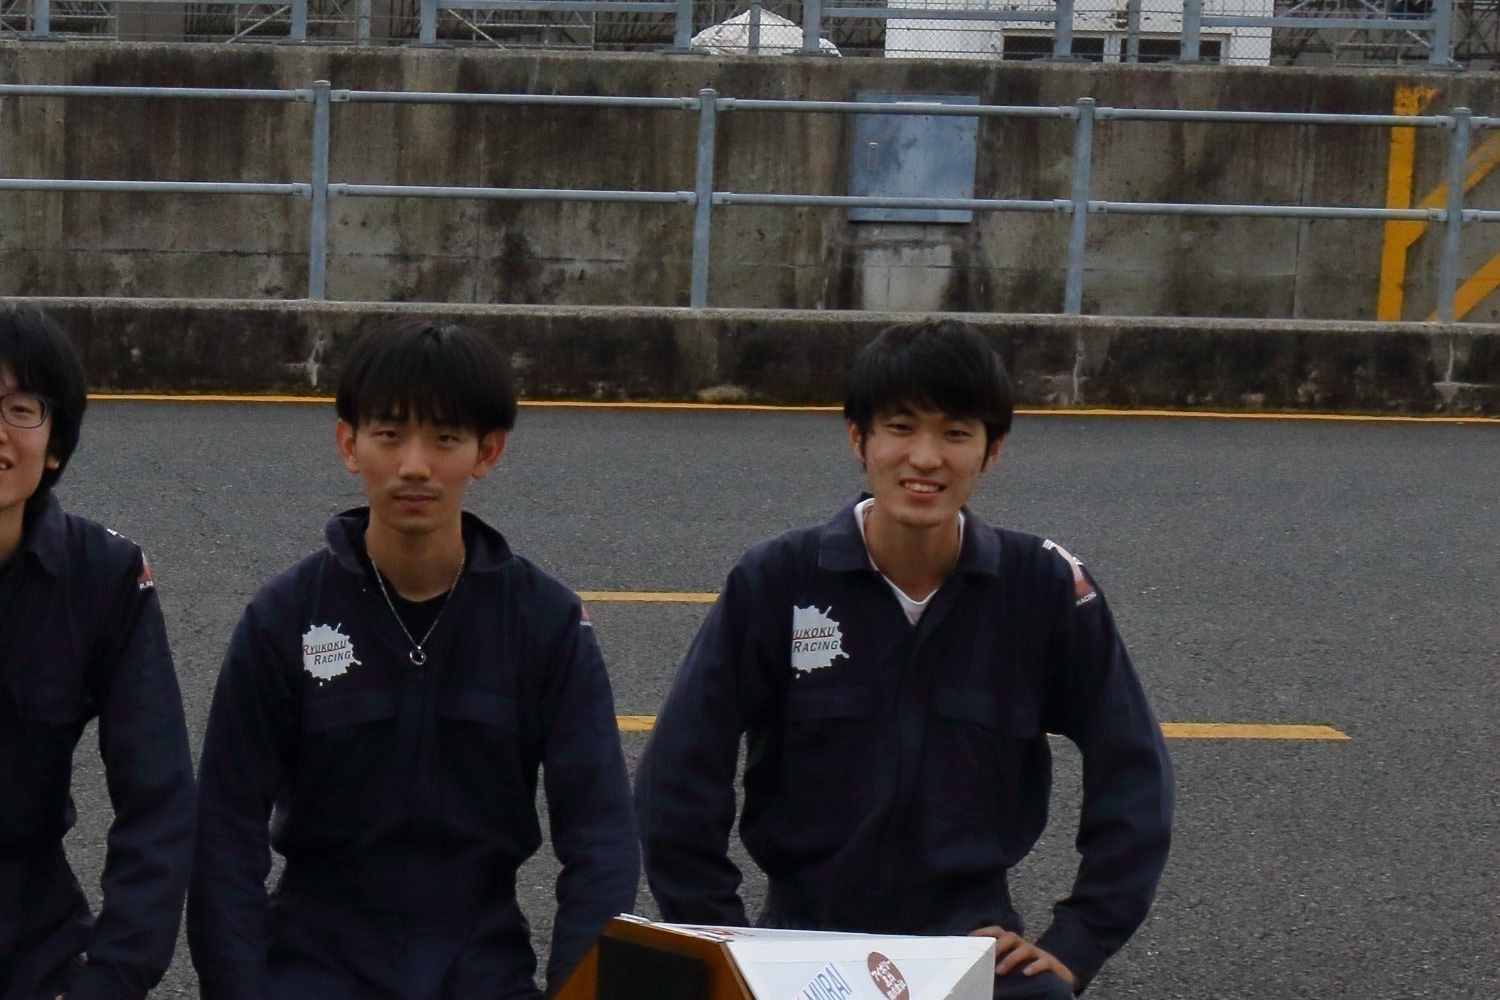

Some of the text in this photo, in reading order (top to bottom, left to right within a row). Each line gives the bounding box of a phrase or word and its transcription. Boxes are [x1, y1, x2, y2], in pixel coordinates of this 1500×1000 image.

[303, 640, 347, 655] RYUKOKU
[792, 640, 839, 653] RACING
[314, 650, 351, 666] RACING
